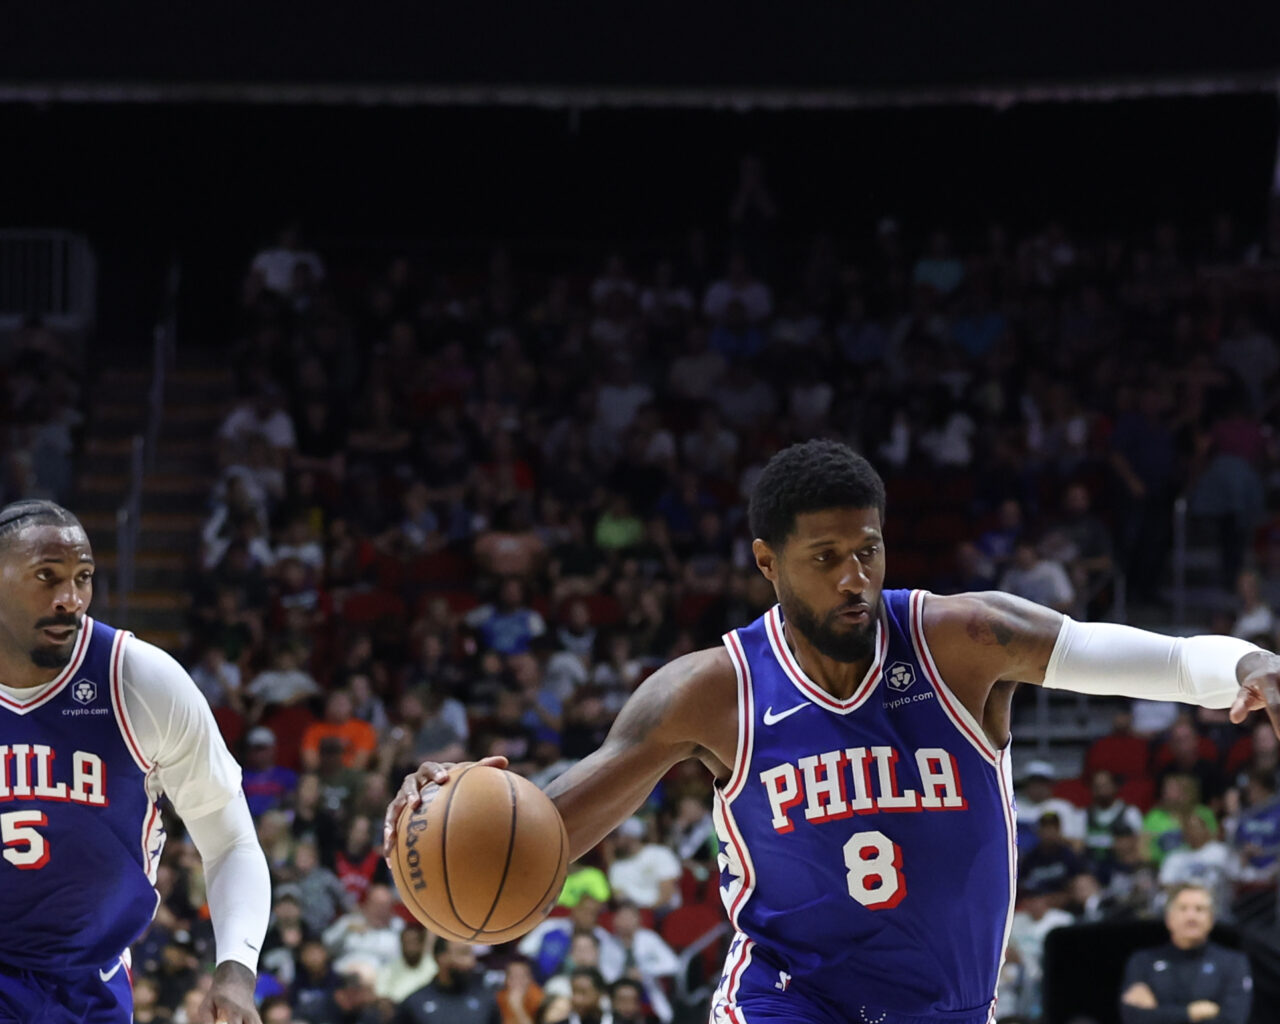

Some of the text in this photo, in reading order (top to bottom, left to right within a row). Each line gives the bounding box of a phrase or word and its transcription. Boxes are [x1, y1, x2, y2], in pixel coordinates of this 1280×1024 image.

[62, 707, 108, 716] crypto.com
[760, 746, 968, 834] PHILA
[0, 810, 50, 870] 5
[843, 830, 907, 911] 8
